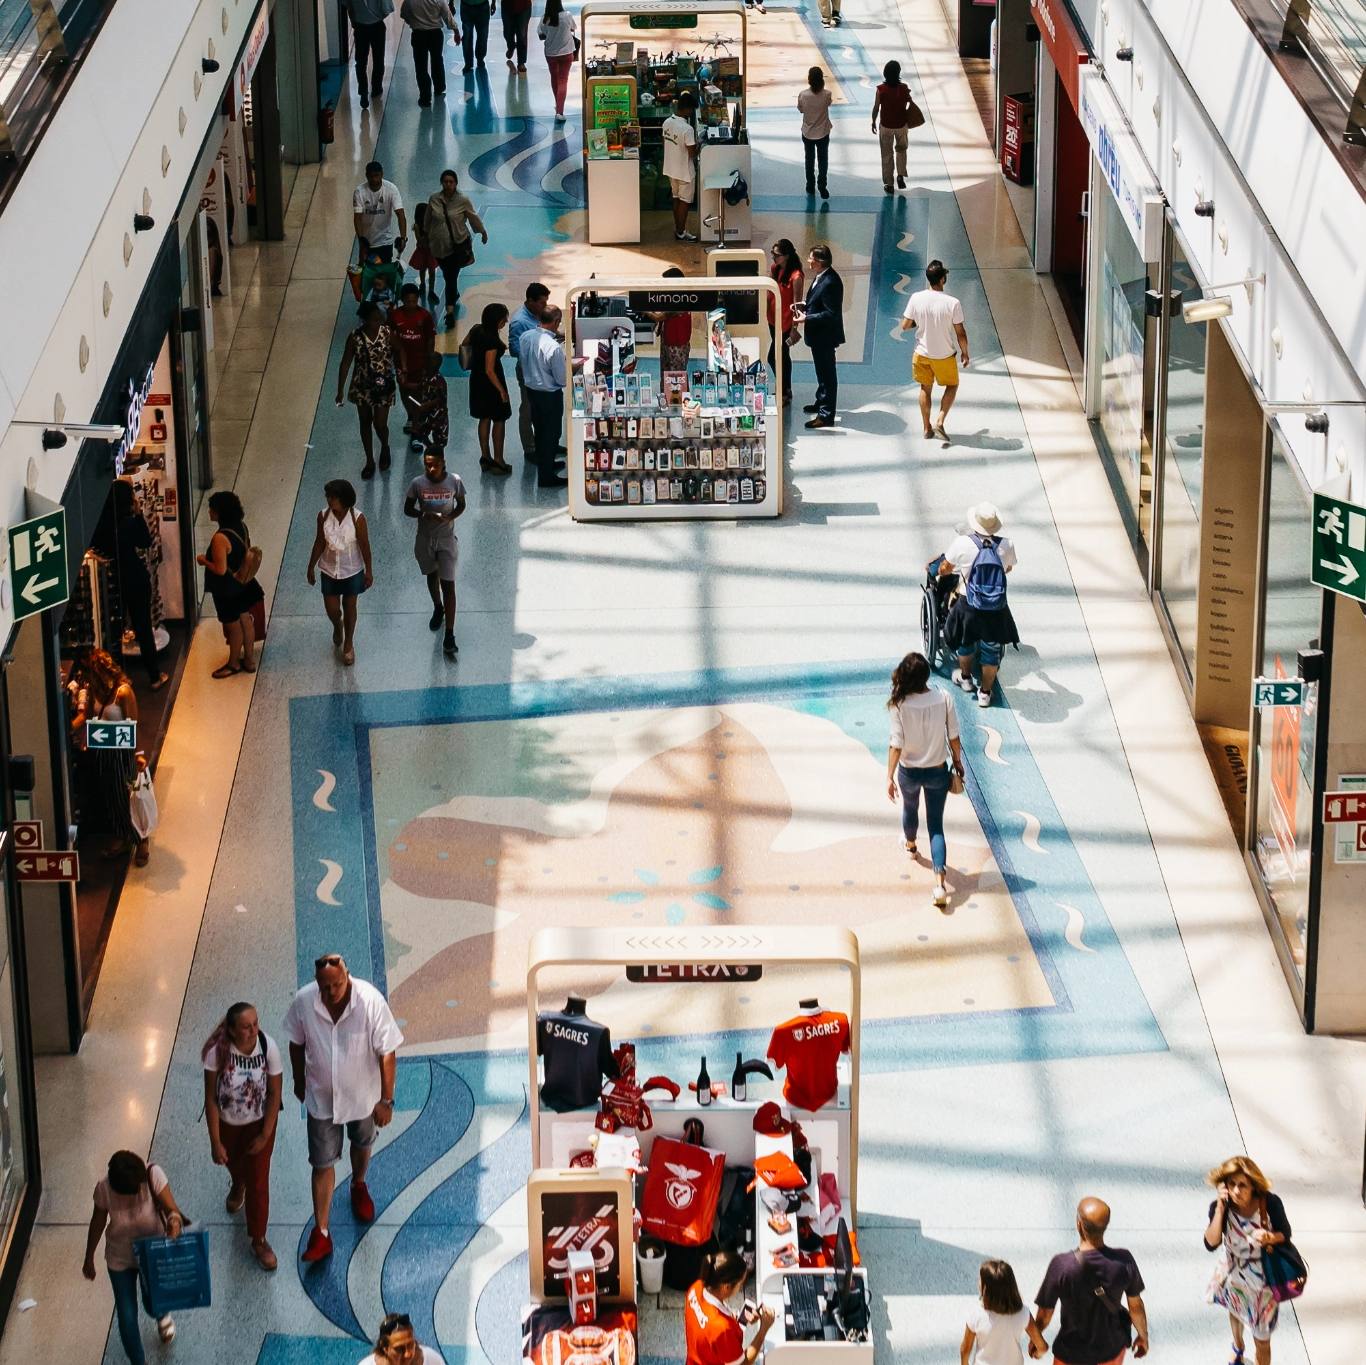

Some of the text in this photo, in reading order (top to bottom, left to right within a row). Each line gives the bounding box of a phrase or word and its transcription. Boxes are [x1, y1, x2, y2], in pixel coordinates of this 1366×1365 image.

[648, 292, 699, 303] kimono
[1213, 520, 1235, 528] almaty
[1211, 586, 1244, 594] casablanca
[1211, 597, 1226, 605] doha
[1209, 636, 1230, 644] luanda
[642, 964, 731, 977] TETRA
[554, 1024, 589, 1046] SAGRES
[805, 1020, 840, 1040] SAGRES
[573, 1216, 601, 1243] TETRA
